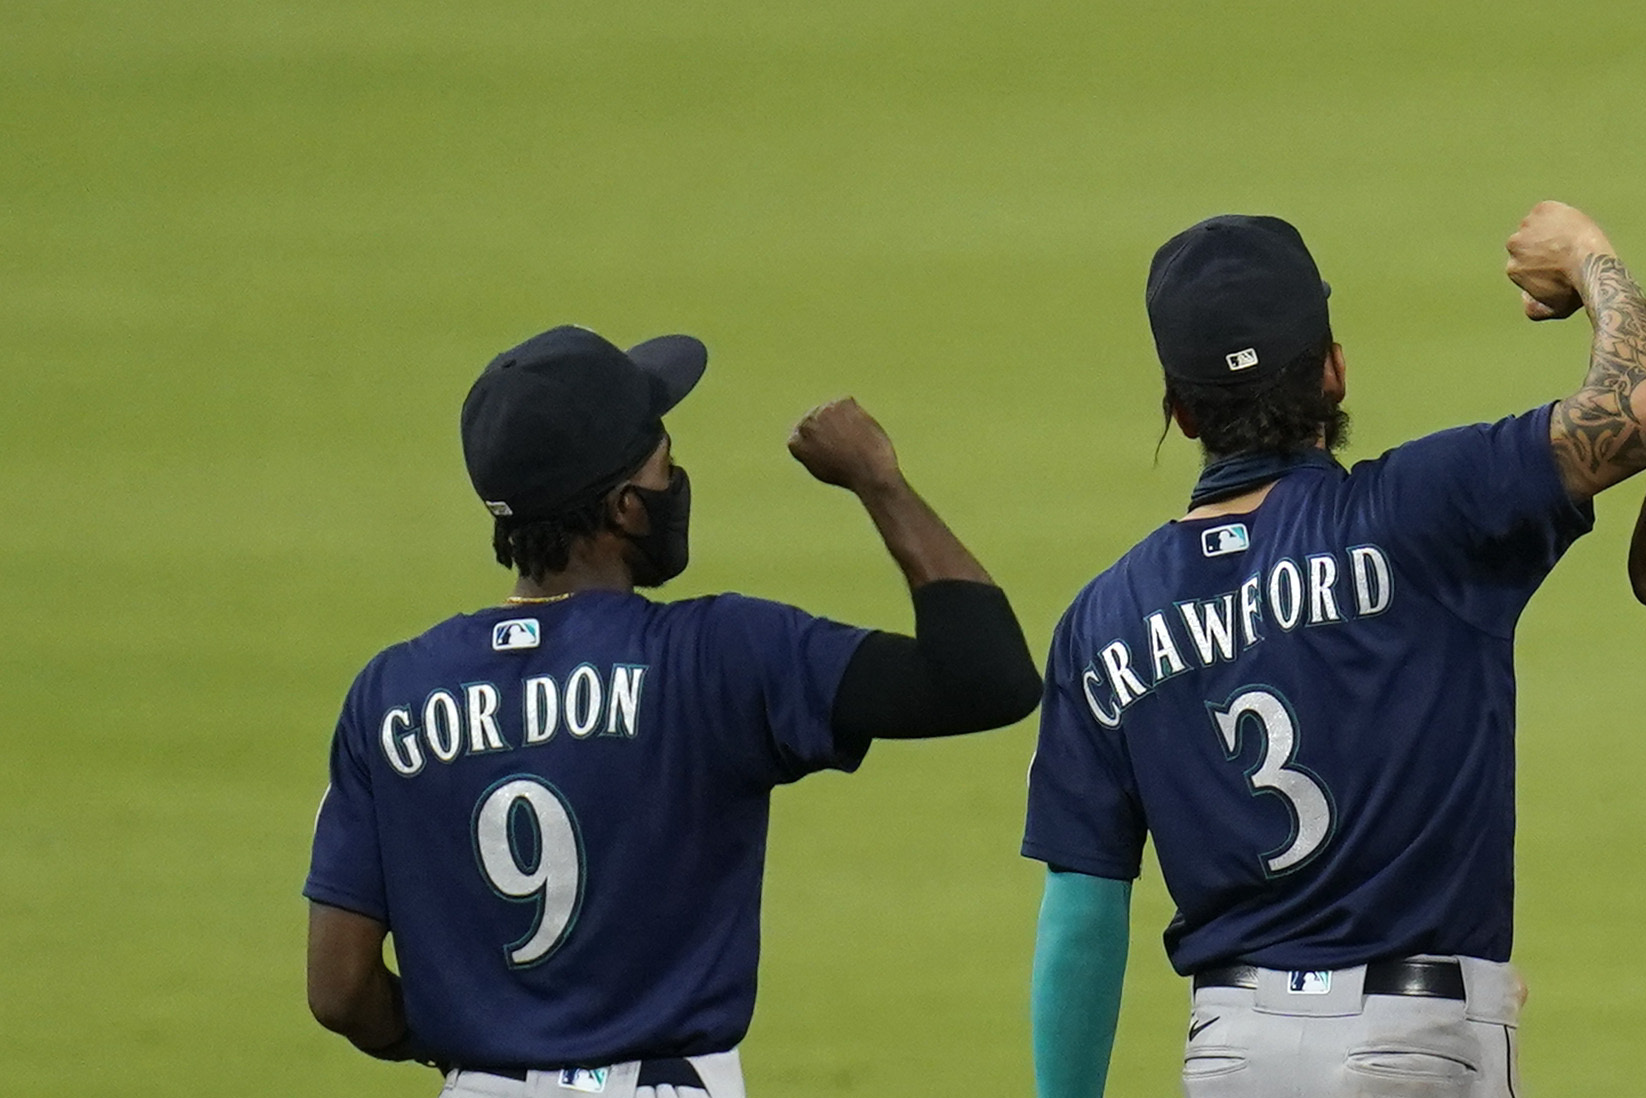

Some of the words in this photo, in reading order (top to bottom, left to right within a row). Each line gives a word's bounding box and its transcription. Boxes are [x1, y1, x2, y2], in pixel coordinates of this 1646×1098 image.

[380, 662, 649, 778] GORDON
[1082, 543, 1395, 730] CRAWFORD
[470, 773, 587, 970] 9
[1206, 683, 1337, 879] 3
